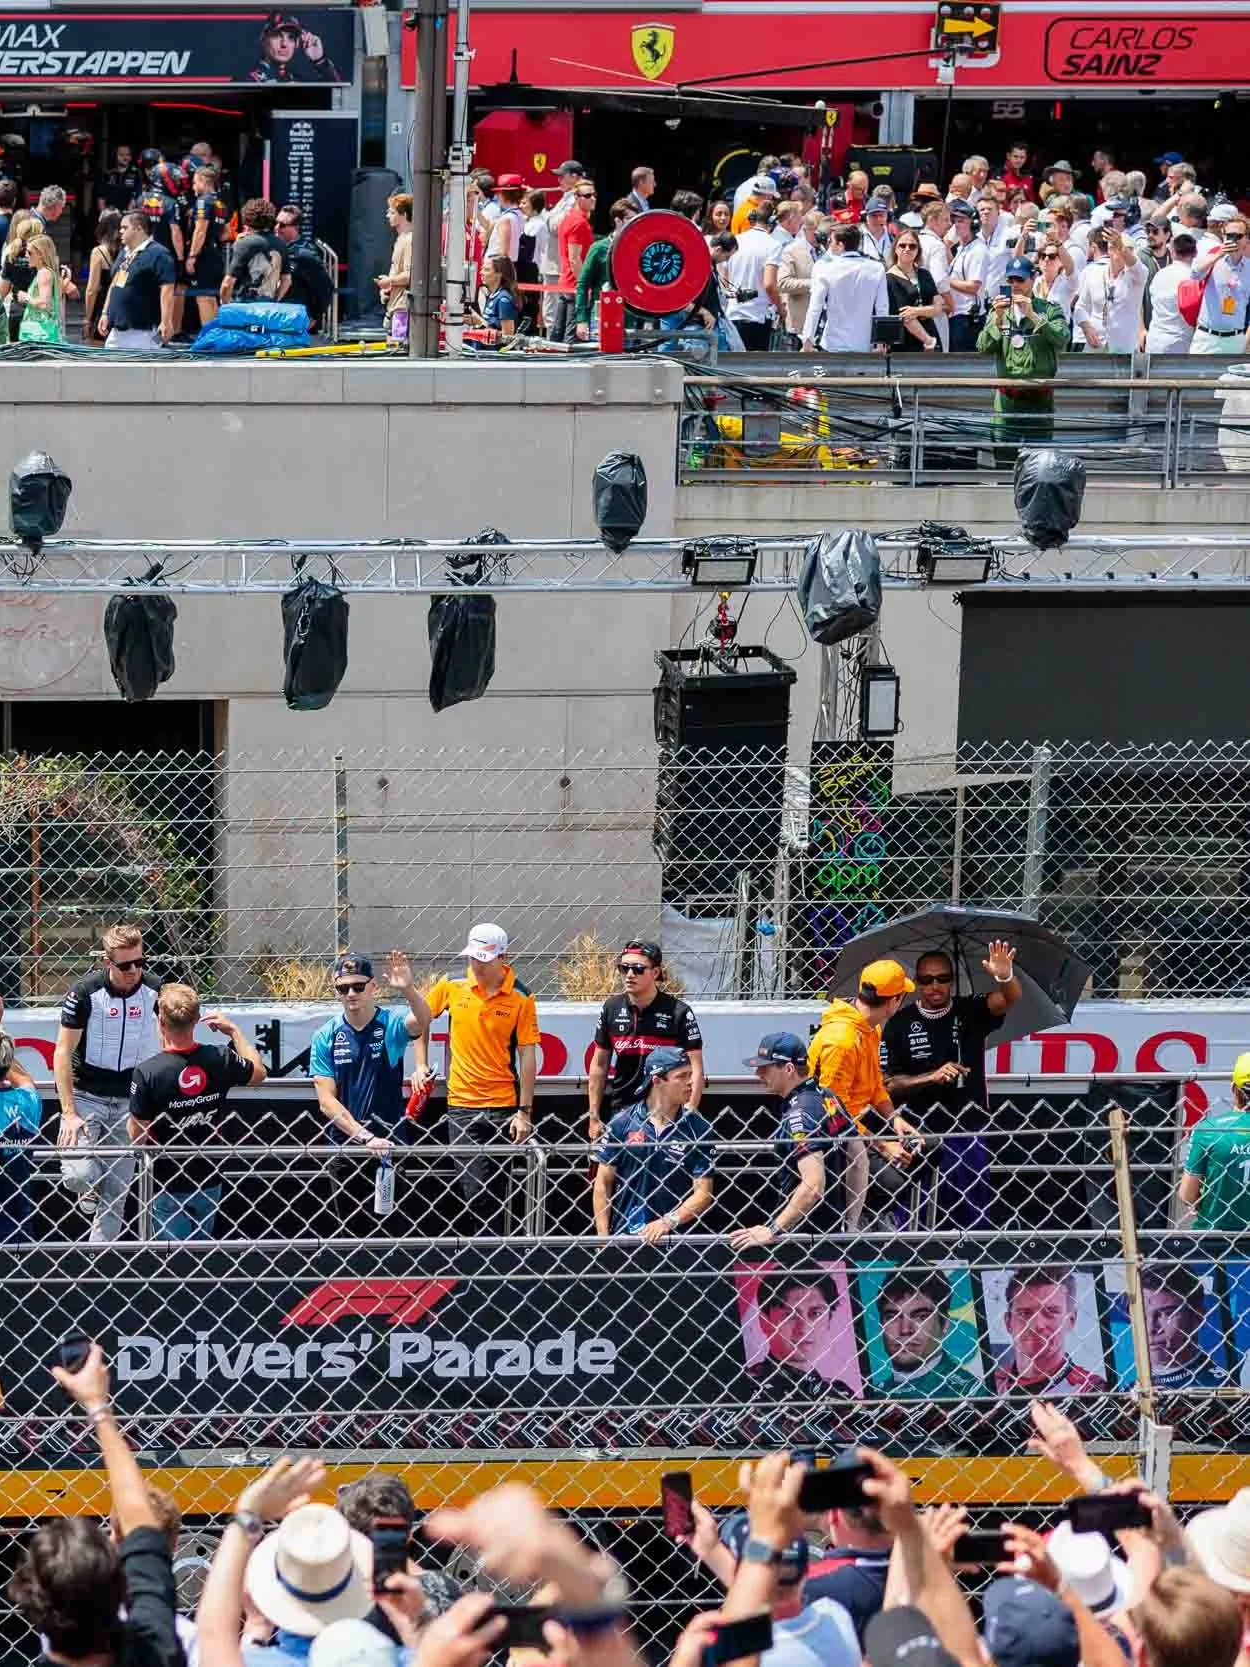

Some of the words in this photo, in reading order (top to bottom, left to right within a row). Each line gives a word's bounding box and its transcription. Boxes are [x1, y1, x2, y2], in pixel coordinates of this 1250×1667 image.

[1070, 27, 1198, 50] CARLOS
[1061, 54, 1162, 76] SAINZ
[992, 101, 1025, 119] 55
[168, 1093, 220, 1109] MoneyGram
[389, 1330, 615, 1378] Parade
